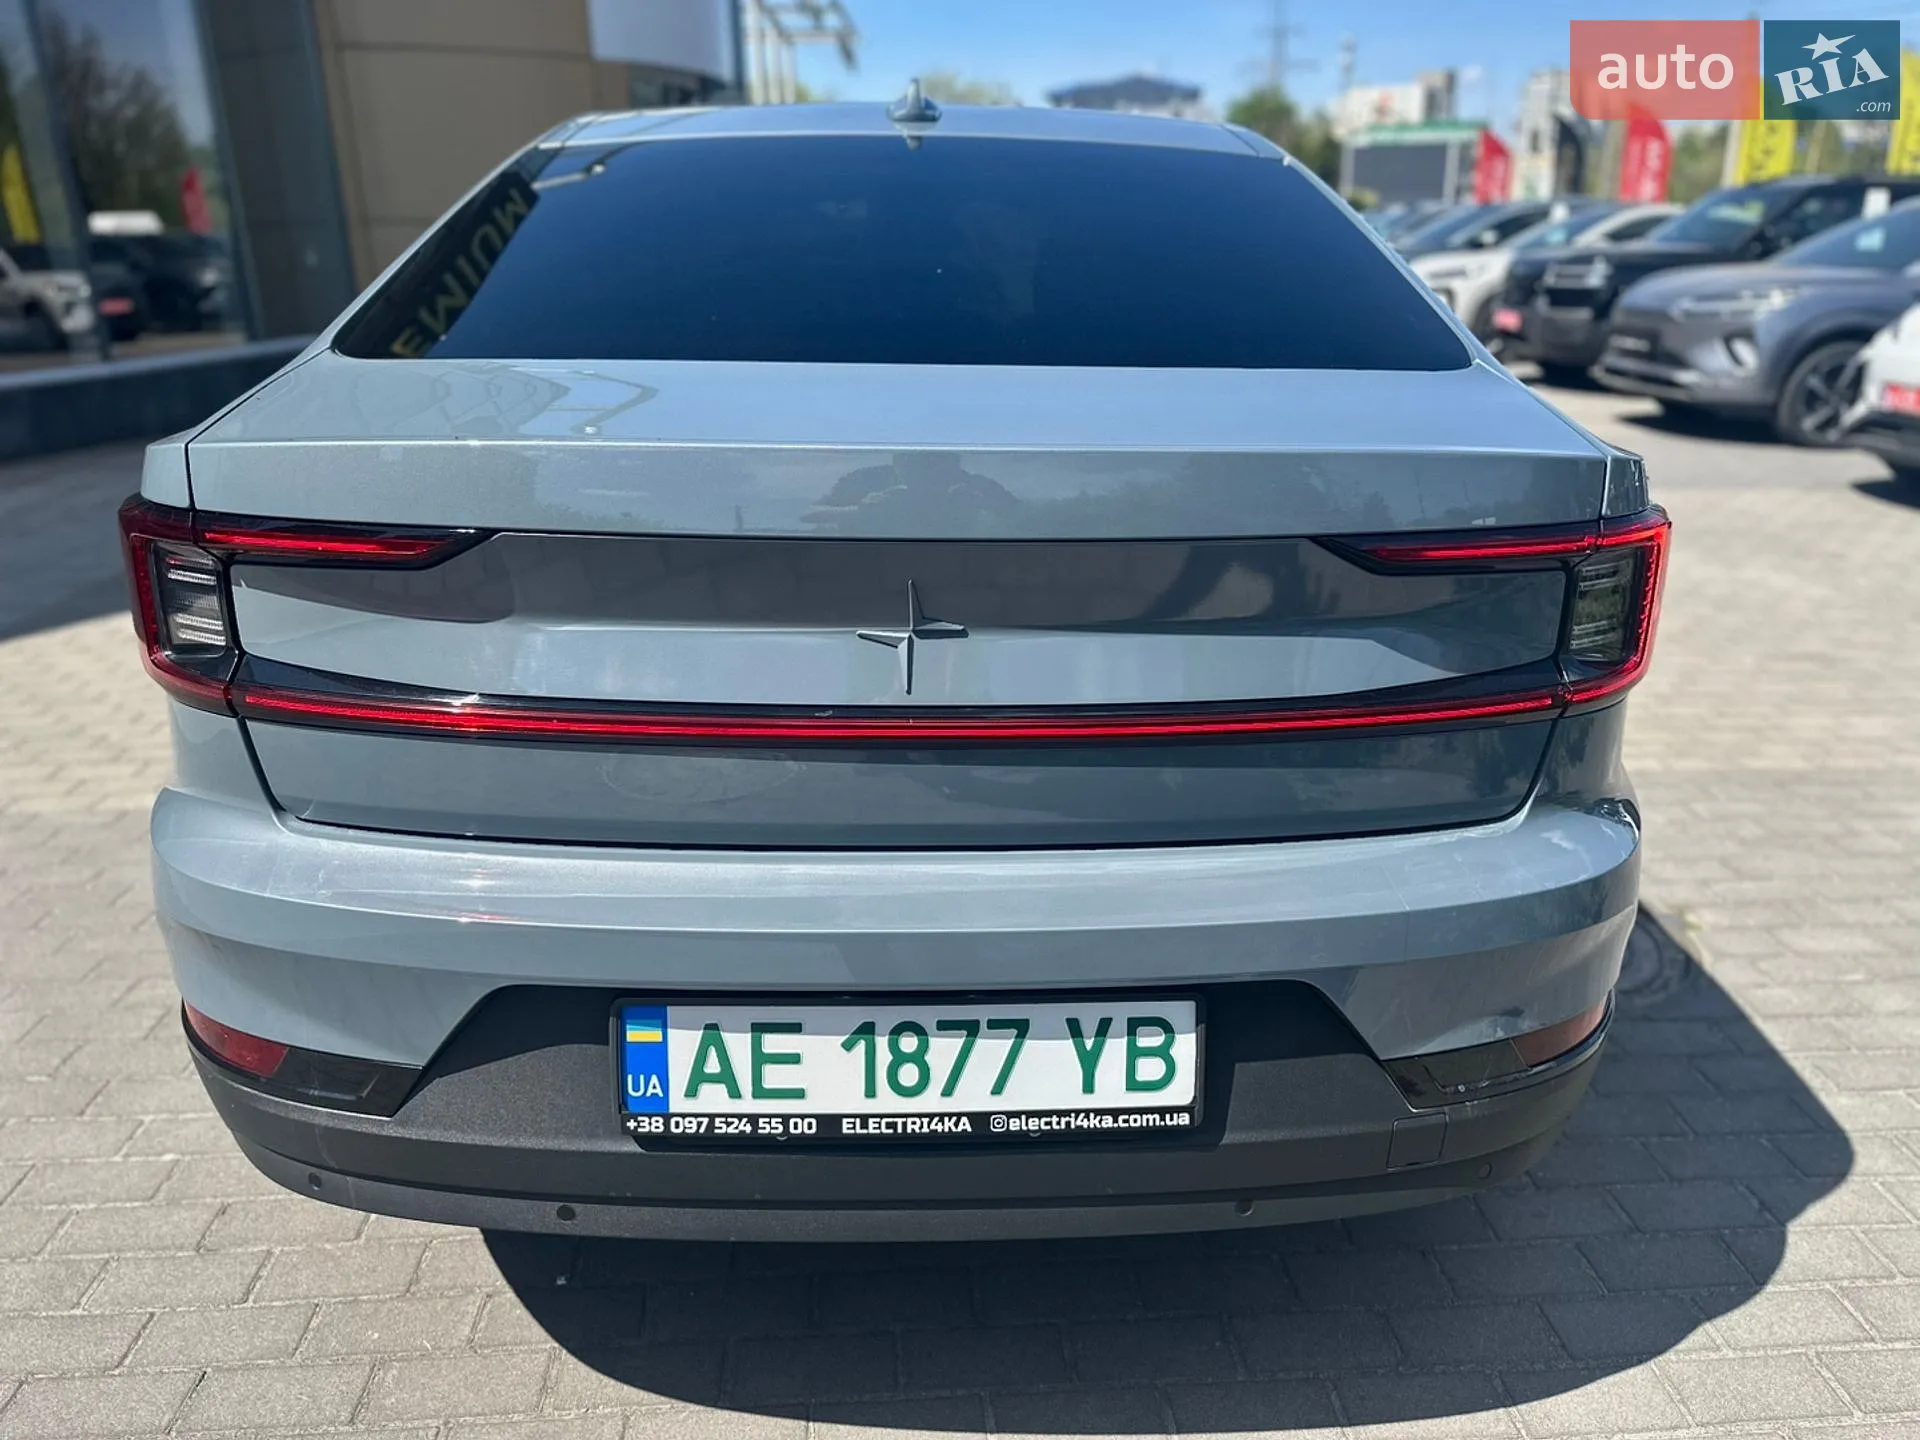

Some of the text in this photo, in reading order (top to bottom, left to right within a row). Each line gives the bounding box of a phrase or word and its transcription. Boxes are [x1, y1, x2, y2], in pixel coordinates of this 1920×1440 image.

[683, 1016, 1177, 1100] AE 1877 YB
[627, 1074, 664, 1098] UA
[626, 1117, 817, 1135] +38 097 524 55 00
[842, 1116, 972, 1135] ELECTRI4KA
[1008, 1111, 1190, 1132] electri4ka.com.ua
